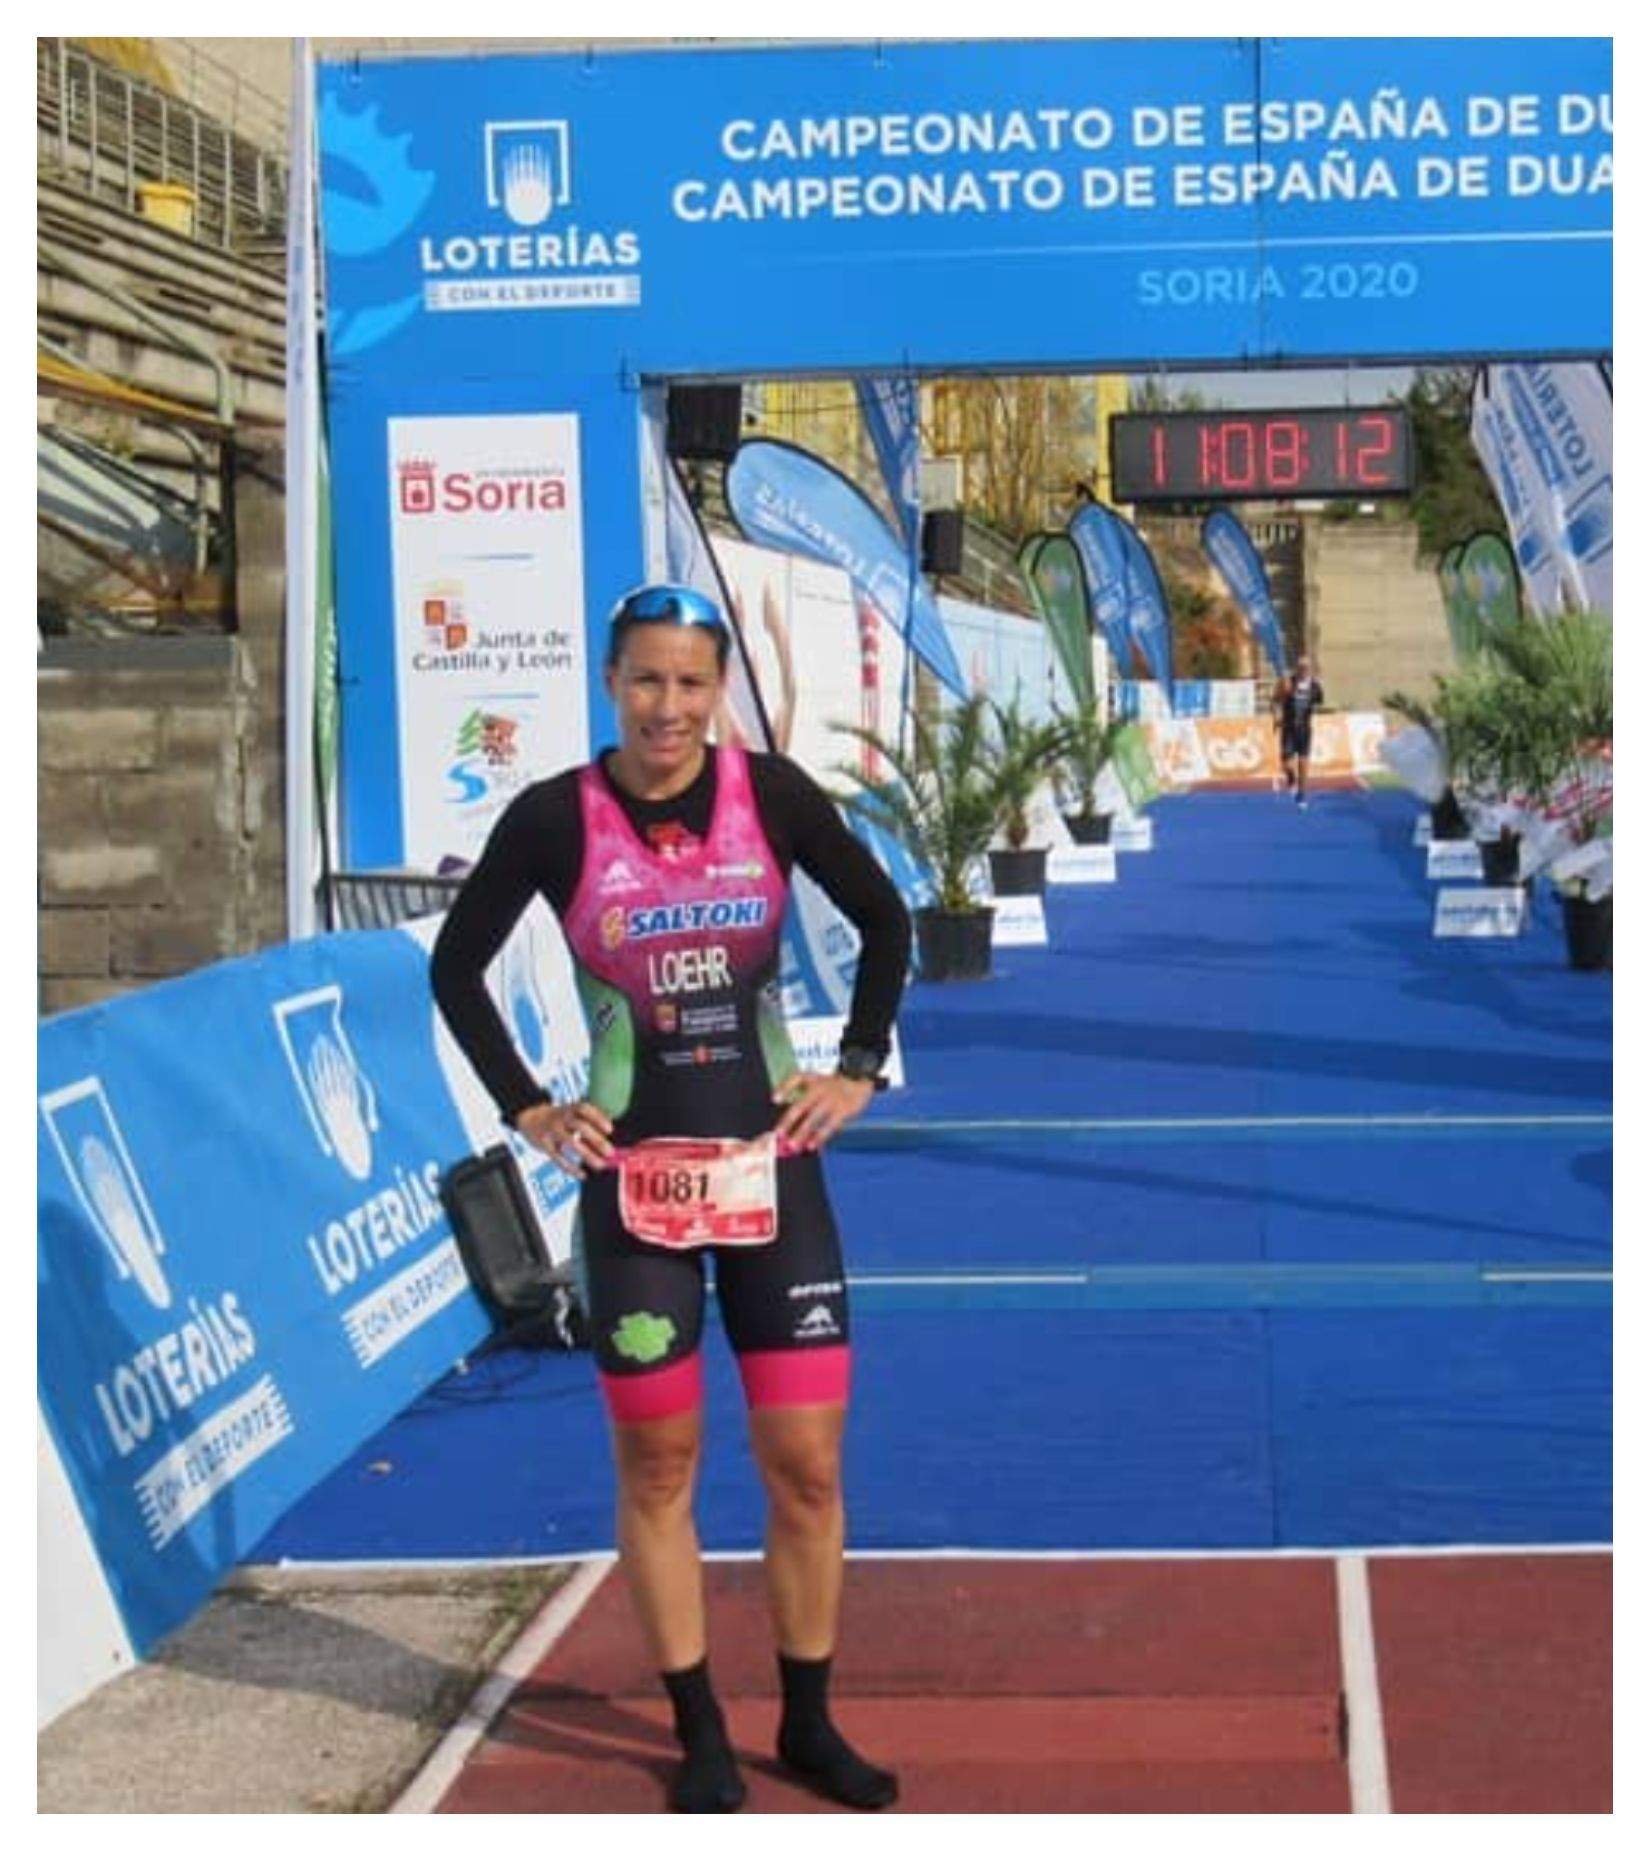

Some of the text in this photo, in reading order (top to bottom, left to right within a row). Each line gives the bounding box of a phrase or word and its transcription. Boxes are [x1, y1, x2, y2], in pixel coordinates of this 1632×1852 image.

[721, 106, 1114, 162] CAMPEONATO
[1133, 105, 1205, 147] DE
[1223, 87, 1449, 145] ESPAÑA
[1467, 95, 1541, 136] DE
[672, 167, 1065, 222] CAMPEONATO
[1083, 166, 1155, 209] DE
[1174, 150, 1398, 206] ESPAÑA
[1417, 155, 1489, 197] DE
[421, 225, 642, 272] LOTERÍAS
[1138, 262, 1419, 305] SORIA 2020
[1150, 417, 1392, 488] 11:08:12
[443, 473, 566, 513] Soria
[412, 651, 572, 674] Castilla y León
[476, 631, 571, 651] Junta de
[628, 898, 768, 938] SALTOKI
[649, 946, 733, 995] LOEHR
[634, 1170, 709, 1206] 1081
[308, 1161, 442, 1296] LOTERÍAS
[93, 1291, 257, 1458] LOTERÍAS
